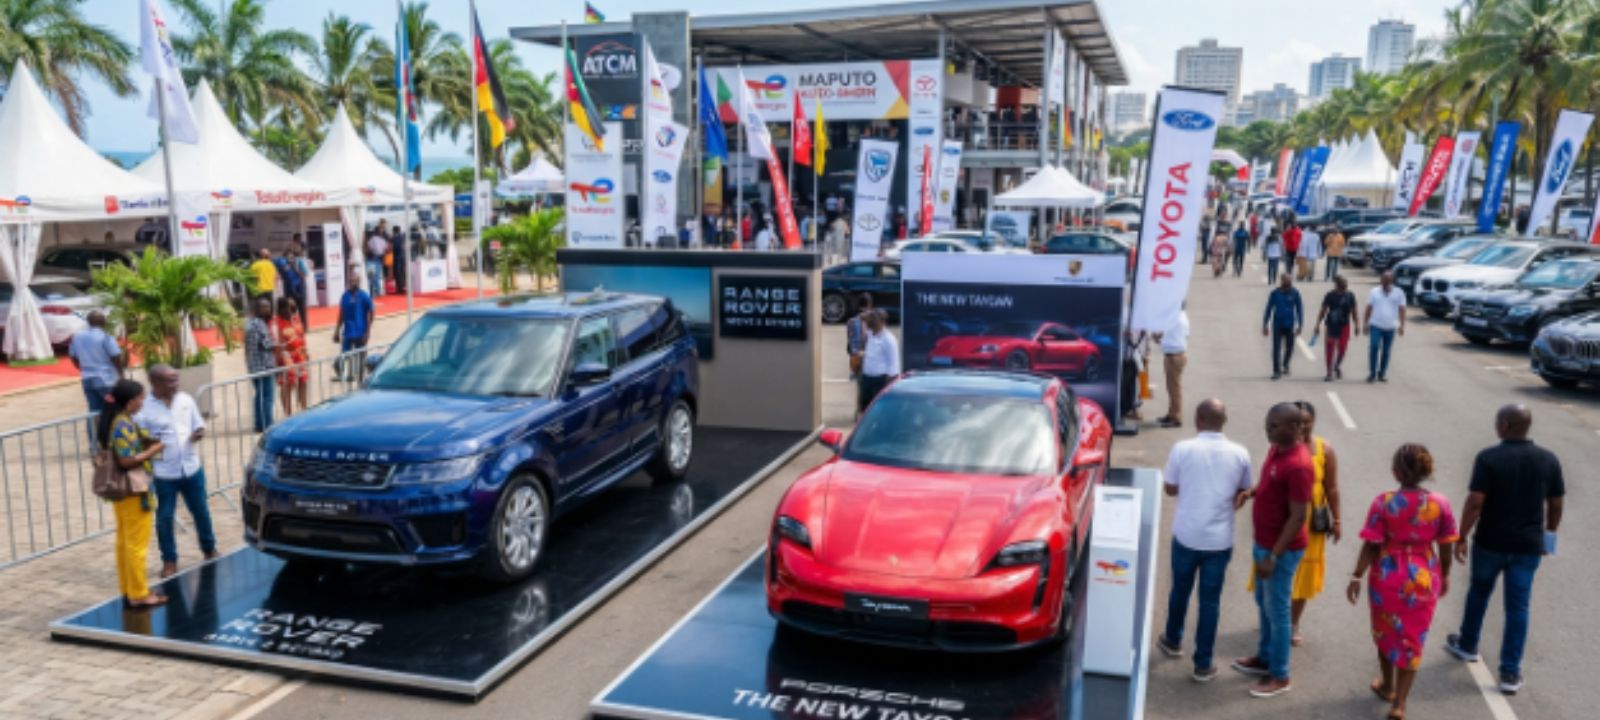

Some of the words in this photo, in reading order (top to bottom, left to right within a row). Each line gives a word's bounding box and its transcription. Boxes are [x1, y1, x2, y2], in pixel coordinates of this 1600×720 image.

[583, 53, 637, 74] ATCM
[798, 69, 877, 86] MAPUTO
[1150, 161, 1193, 282] TOYOTA
[723, 287, 800, 300] RANGE
[916, 291, 937, 306] THE
[723, 301, 801, 315] ROVER
[243, 607, 383, 635] RANGE
[219, 619, 366, 649] ROVER
[733, 688, 791, 711] THE
[793, 698, 870, 720] NEW
[780, 678, 966, 711] PORSCHE
